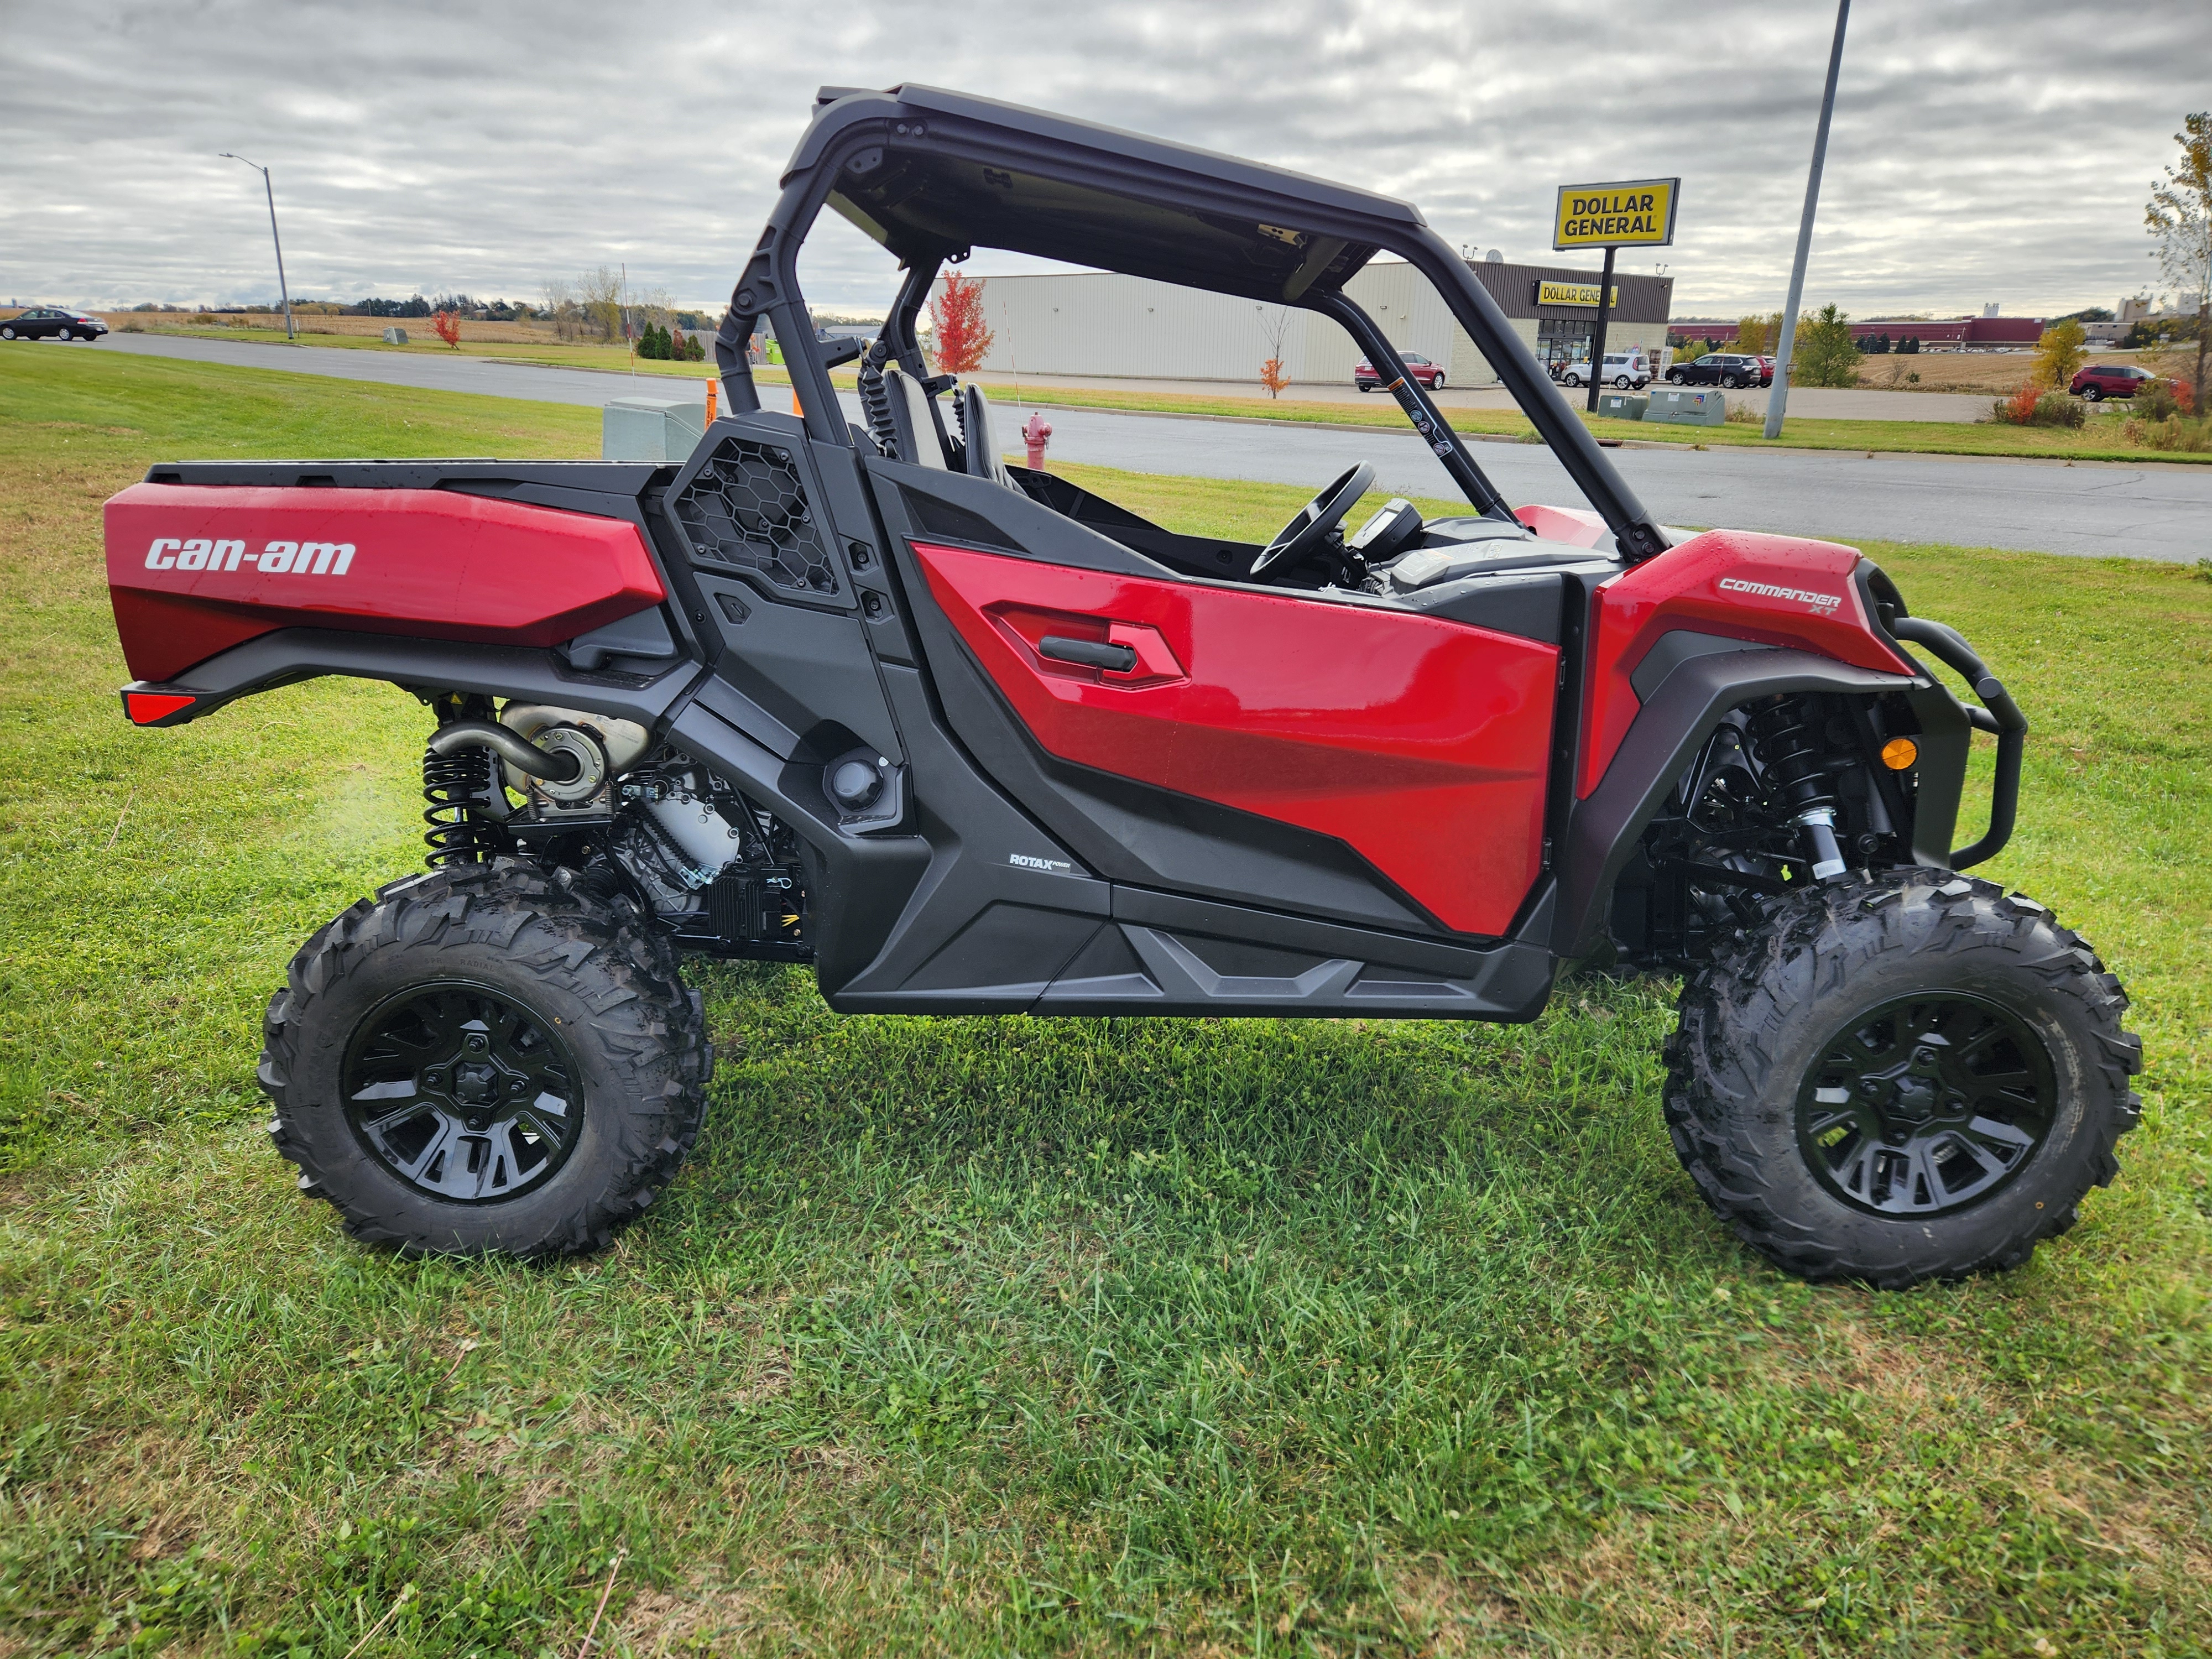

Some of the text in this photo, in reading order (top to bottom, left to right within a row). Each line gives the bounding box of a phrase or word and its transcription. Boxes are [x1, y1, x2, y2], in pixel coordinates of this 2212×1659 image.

[1573, 195, 1653, 215] DOLLAR
[1564, 215, 1656, 236] GENERAL
[1544, 286, 1615, 302] DOLLAR GENEL
[144, 538, 356, 575] can-am
[1720, 578, 1841, 607] COMMANDER
[1809, 604, 1837, 615] XT
[1009, 854, 1053, 870] ROTAX
